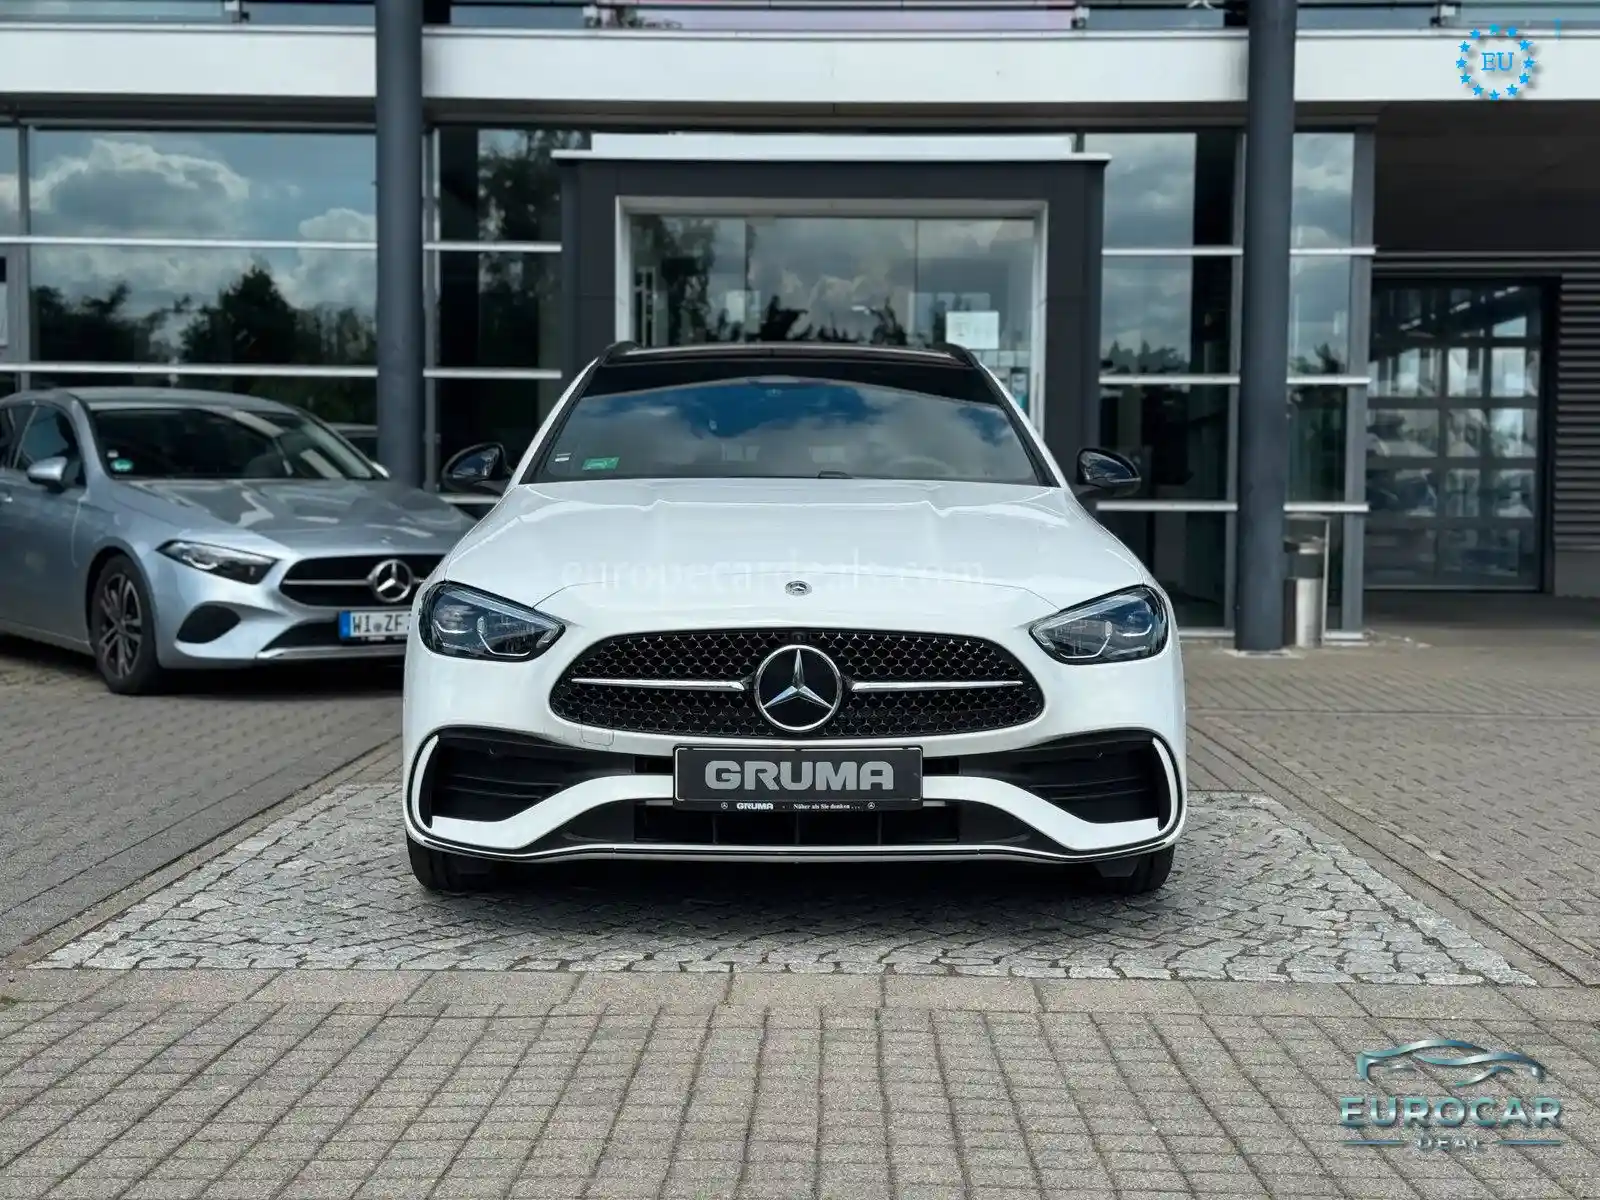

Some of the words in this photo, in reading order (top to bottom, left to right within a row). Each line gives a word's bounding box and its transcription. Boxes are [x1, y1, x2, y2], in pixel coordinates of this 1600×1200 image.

[385, 614, 411, 632] ZF
[704, 760, 894, 791] GRUMA
[736, 802, 774, 810] GRUMA
